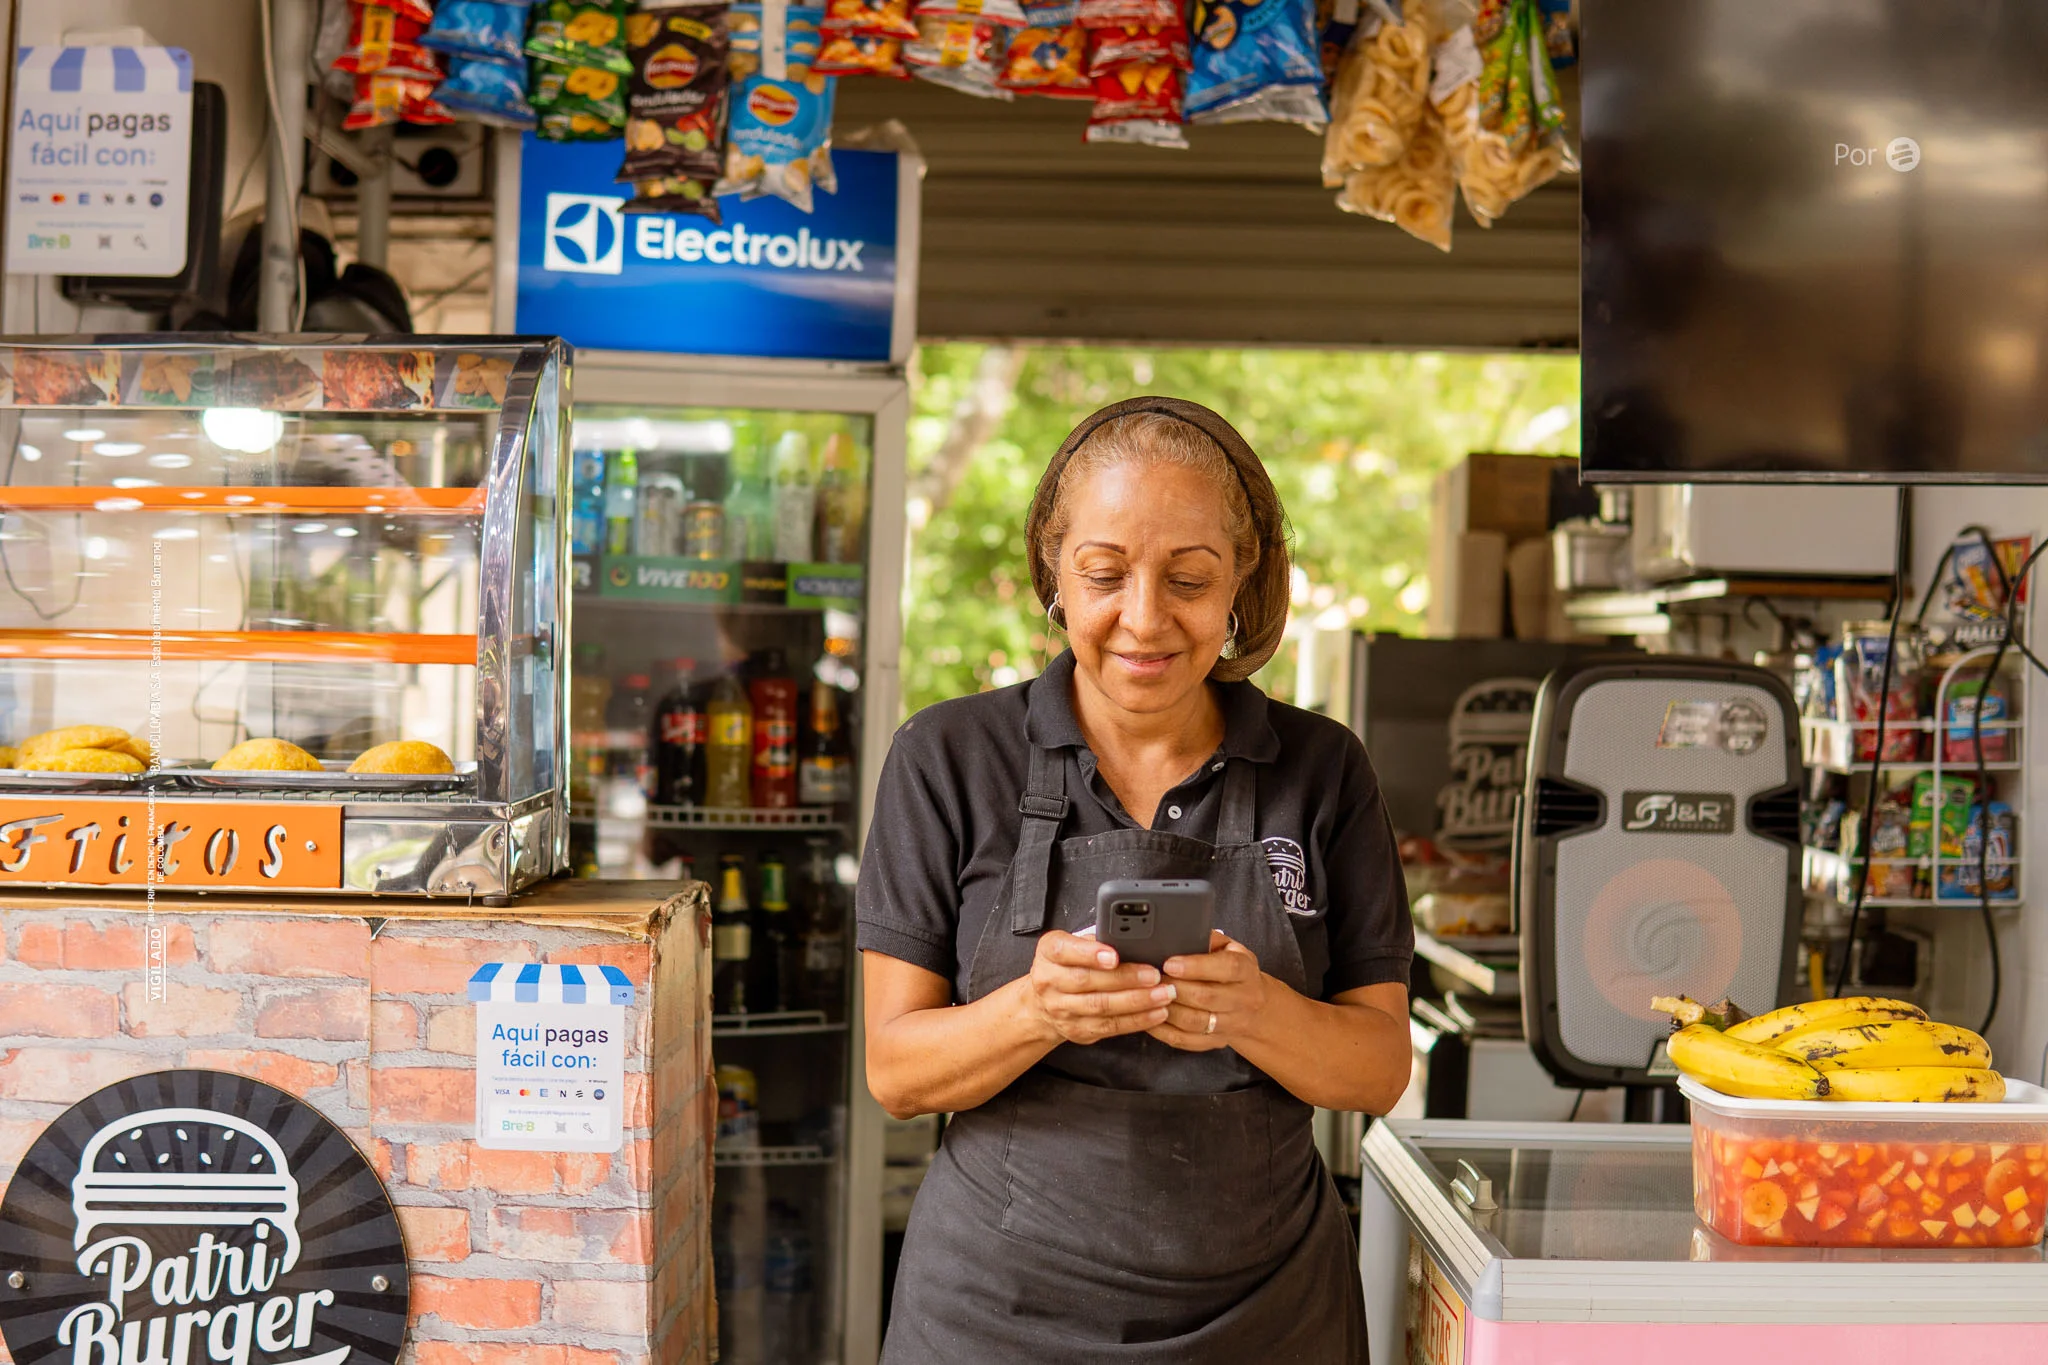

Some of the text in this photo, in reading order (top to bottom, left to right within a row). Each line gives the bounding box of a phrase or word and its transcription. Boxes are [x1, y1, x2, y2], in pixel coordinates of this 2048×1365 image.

[18, 107, 171, 138] Aquí pagas
[30, 141, 156, 166] fácil con:
[635, 216, 865, 272] Electrolux
[1665, 801, 1721, 822] J&R
[0, 813, 287, 879] Fritos
[492, 1023, 609, 1048] Aquí pagas
[502, 1048, 597, 1068] fácil con:
[76, 1222, 280, 1322] Patri
[60, 1289, 335, 1365] Burger
